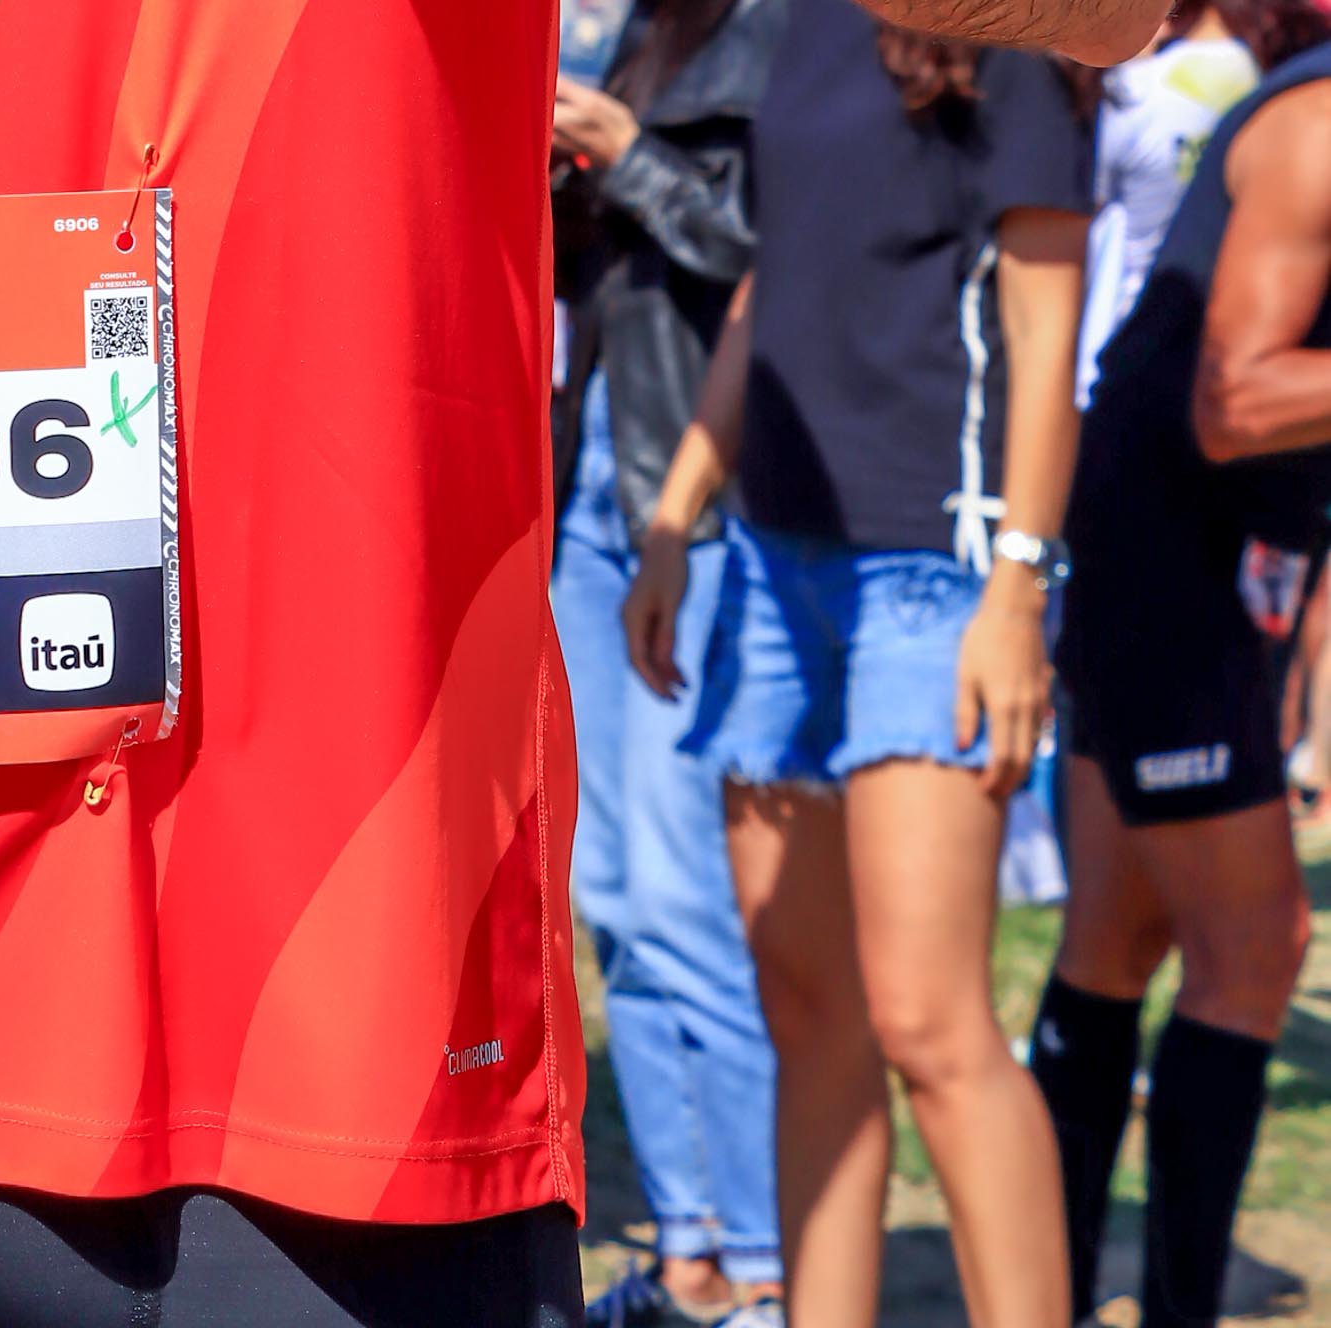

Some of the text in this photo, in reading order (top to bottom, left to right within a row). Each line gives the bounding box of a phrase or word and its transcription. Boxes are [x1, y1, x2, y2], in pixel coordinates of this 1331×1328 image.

[53, 217, 100, 232] 6906
[99, 272, 137, 280] CONSULTE
[89, 279, 148, 289] SEU RESULTADO
[168, 557, 182, 665] CHRONOMAX
[30, 634, 105, 672] itaú
